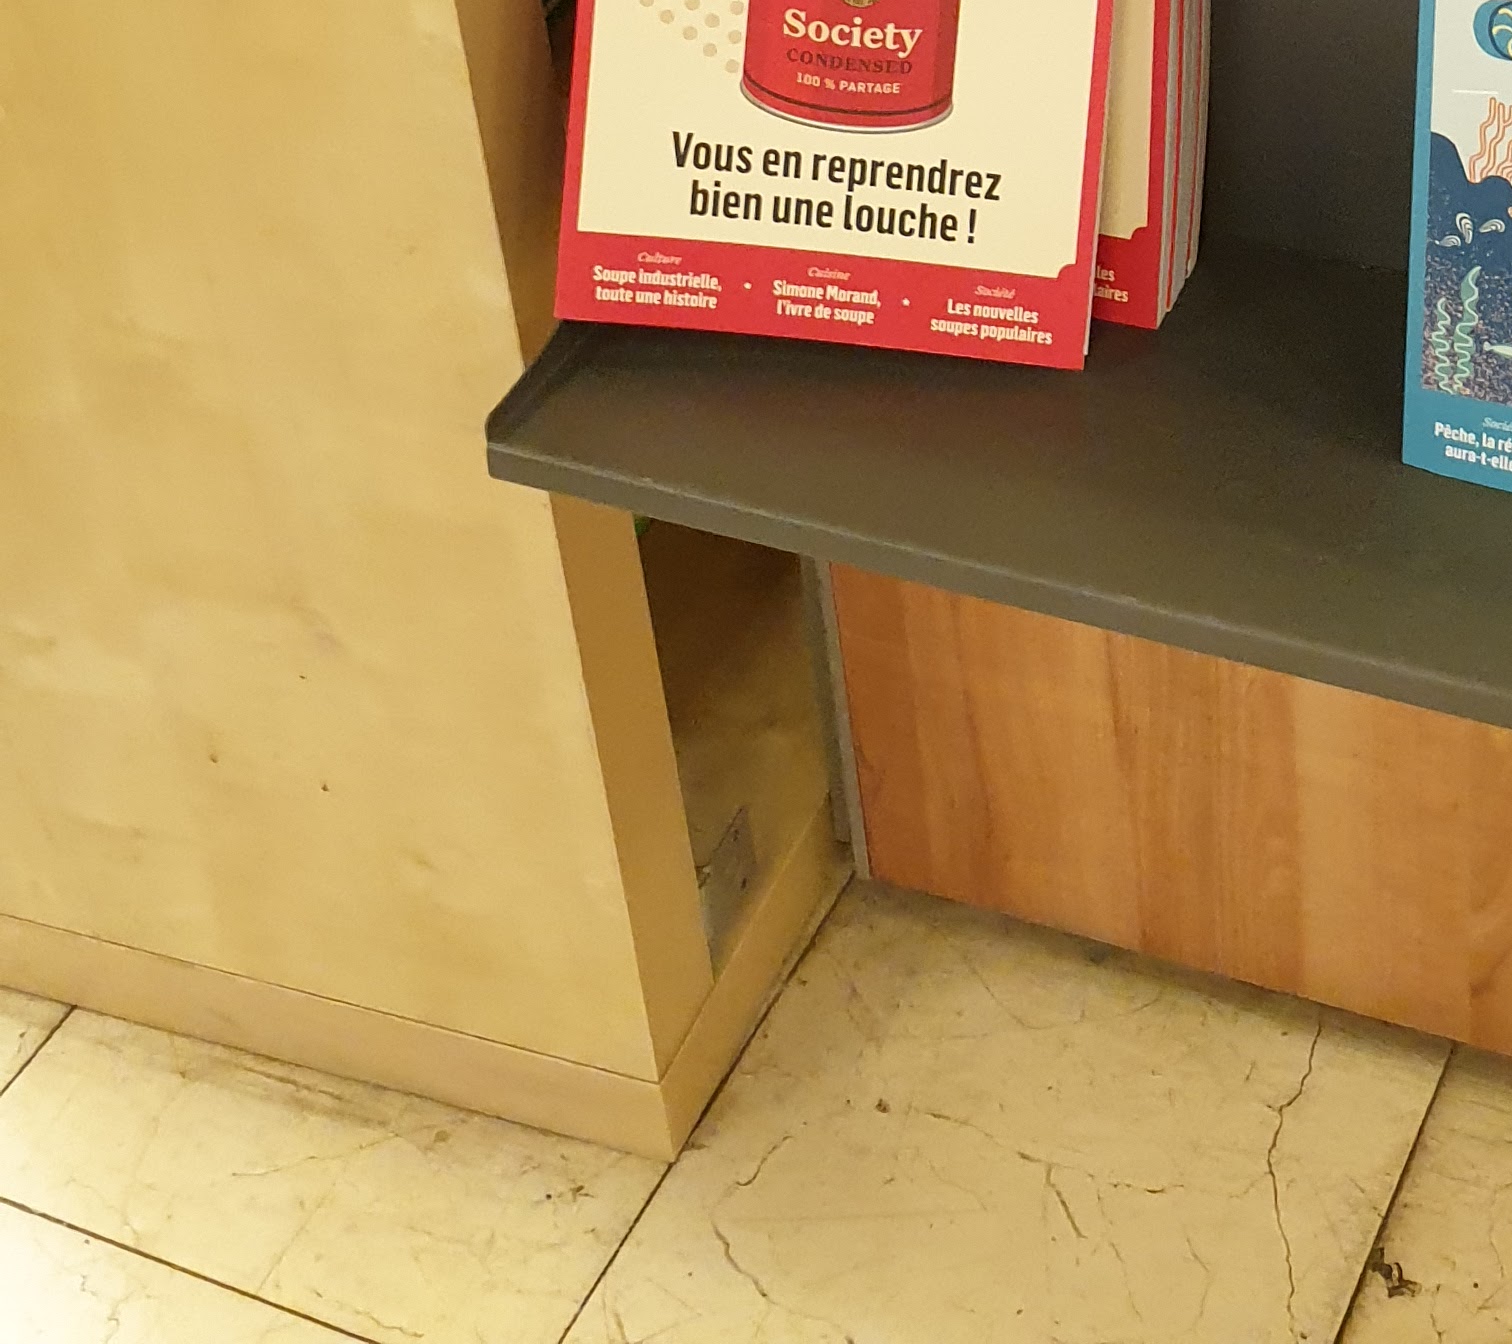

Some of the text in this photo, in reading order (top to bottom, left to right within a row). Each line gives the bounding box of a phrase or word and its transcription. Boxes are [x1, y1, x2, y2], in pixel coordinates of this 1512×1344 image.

[782, 6, 923, 59] Society
[786, 47, 913, 77] CONDENSED
[796, 72, 901, 95] 100 % PARTAGE
[672, 131, 1003, 201] Vous en reprendrez
[689, 179, 958, 242] bien une louche
[947, 298, 1040, 325] Les nouvelles
[930, 316, 1053, 346] soupes populaires
